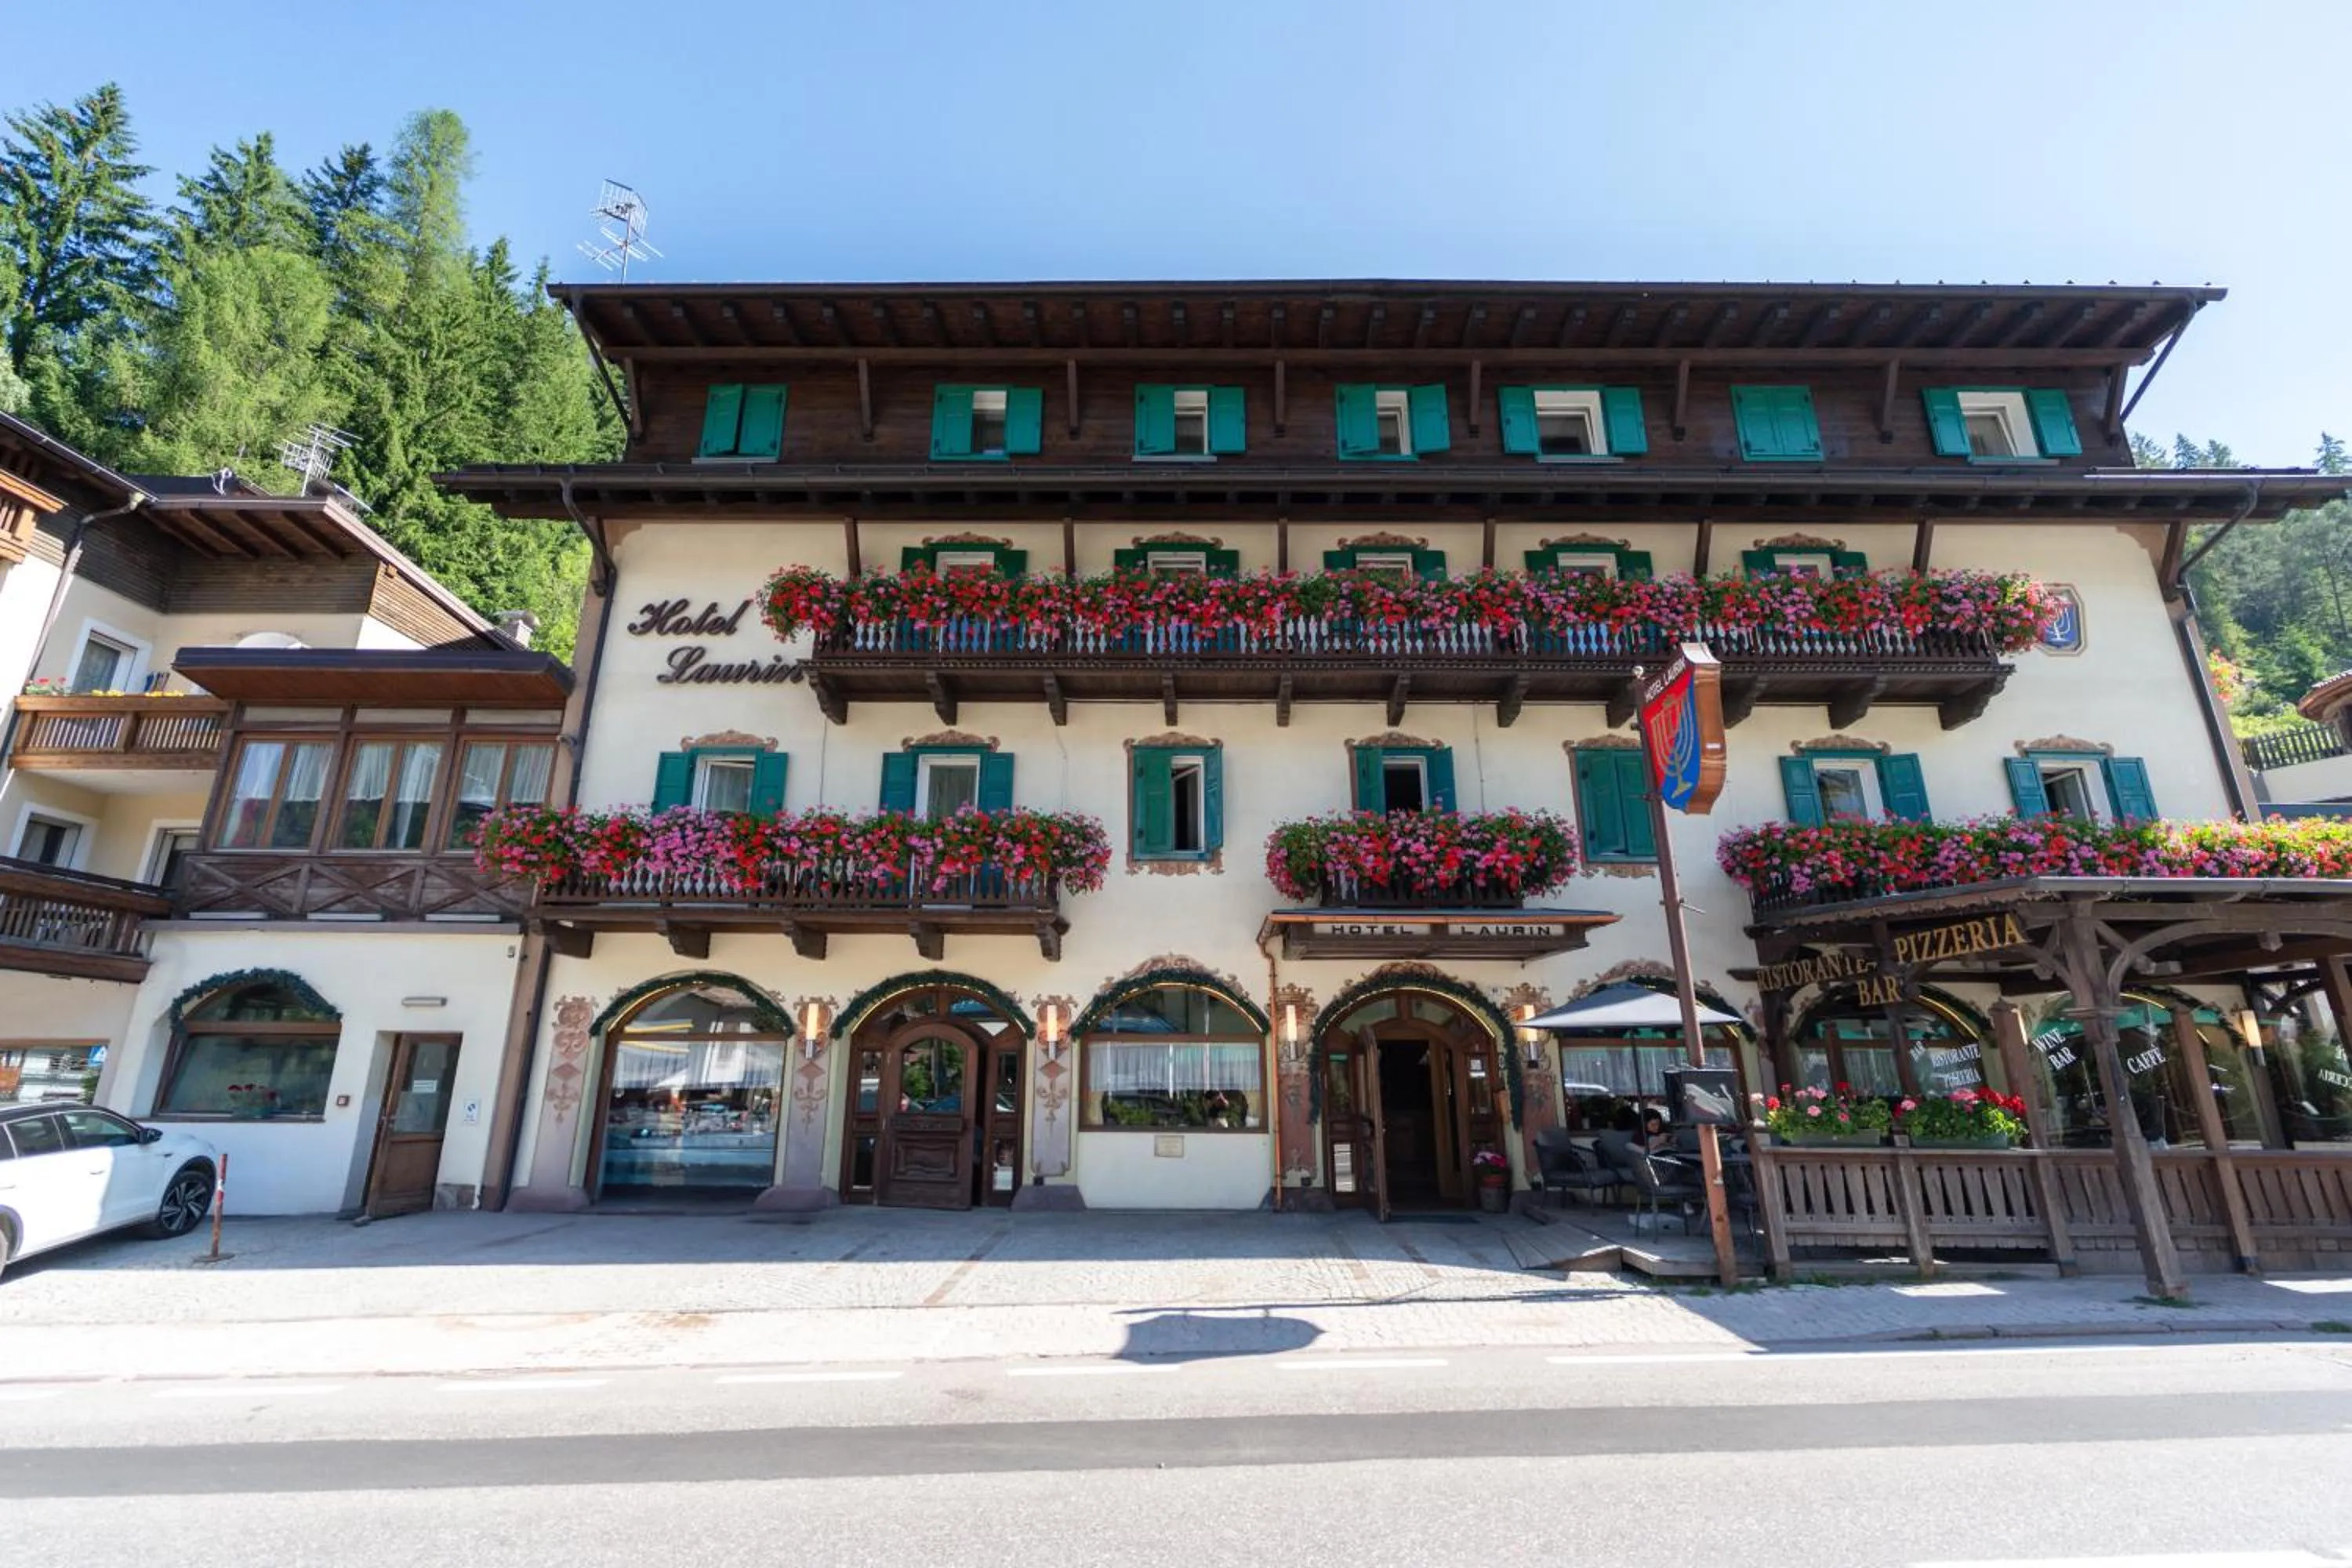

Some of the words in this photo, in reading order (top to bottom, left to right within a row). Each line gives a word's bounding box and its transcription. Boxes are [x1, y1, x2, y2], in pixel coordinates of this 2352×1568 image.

[628, 598, 753, 636] Hotel
[657, 646, 804, 684] Laurin
[1644, 679, 1664, 702] HOTEL
[1663, 655, 1686, 686] LAURIN
[1331, 924, 1414, 935] HOTEL
[1461, 926, 1551, 936] LAURIN
[1894, 913, 2027, 966] PIZZERIA
[1756, 953, 1868, 992] RISTORANTE
[1857, 975, 1903, 1007] BAR
[2032, 1027, 2066, 1052] WINE
[2048, 1047, 2078, 1071] BAR
